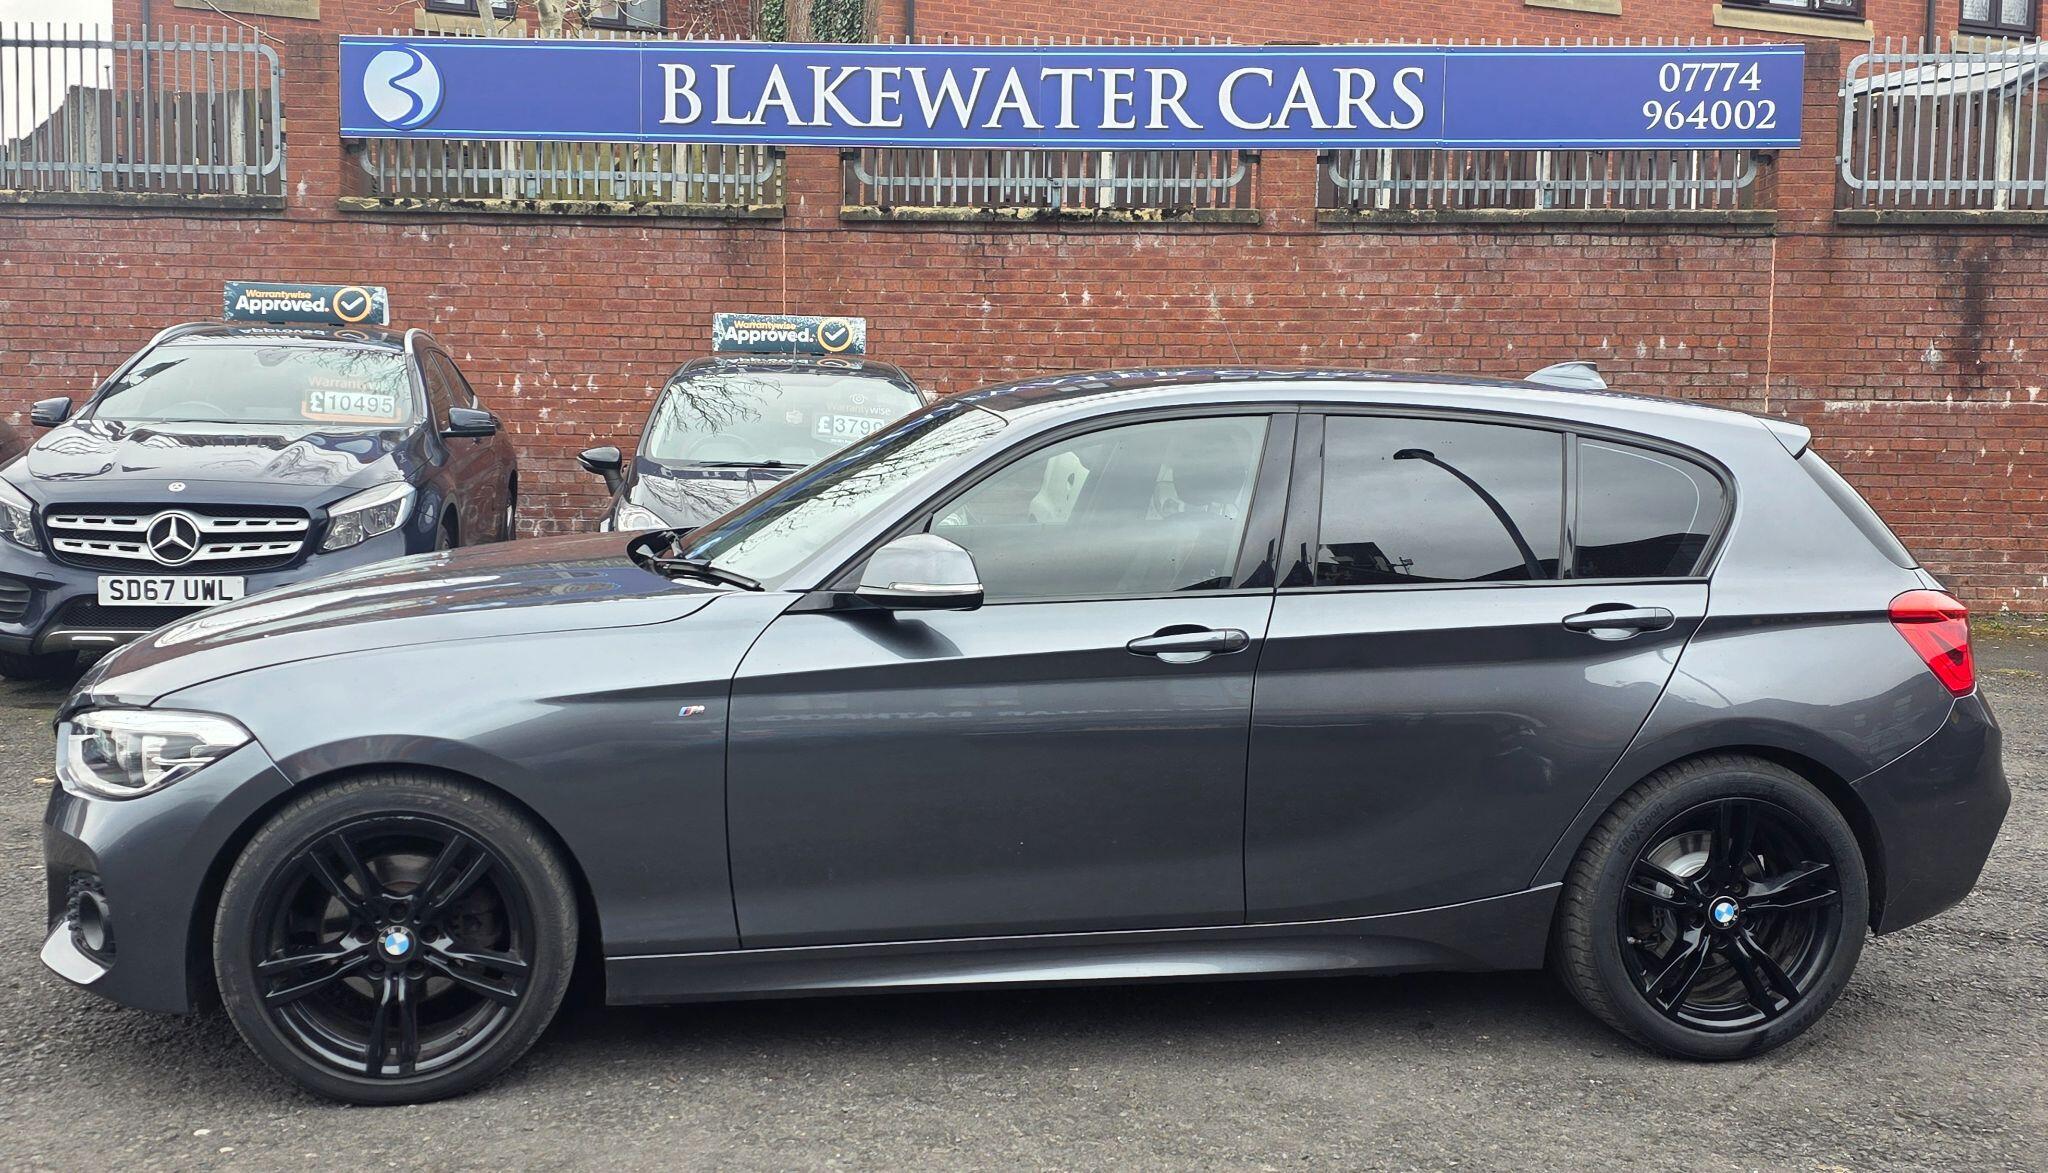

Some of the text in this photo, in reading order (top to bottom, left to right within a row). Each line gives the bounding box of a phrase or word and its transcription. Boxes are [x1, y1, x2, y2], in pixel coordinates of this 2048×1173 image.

[1658, 62, 1762, 93] 07774
[658, 62, 1425, 131] BLAKEWATER CARS
[1642, 99, 1777, 130] 964002
[235, 295, 330, 314] Approved.
[245, 289, 312, 299] Warrantywise
[724, 325, 814, 345] Approved.
[733, 320, 797, 331] Warrantywise
[310, 391, 394, 414] £10495
[109, 579, 234, 601] SD67 UWL
